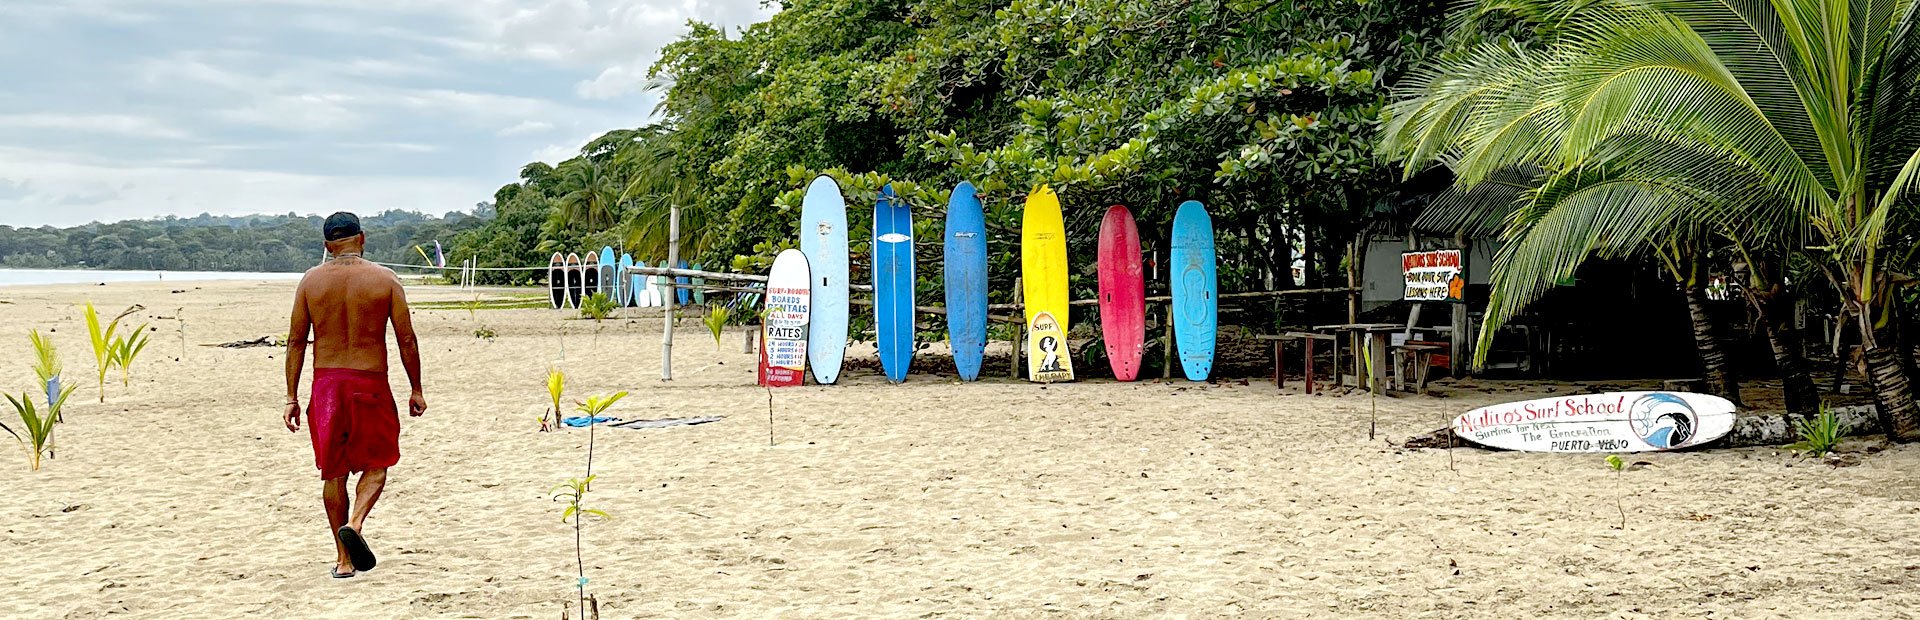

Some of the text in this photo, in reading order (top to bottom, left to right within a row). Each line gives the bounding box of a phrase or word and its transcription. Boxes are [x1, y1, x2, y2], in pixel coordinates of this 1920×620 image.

[771, 295, 801, 304] BOARDS
[1034, 323, 1053, 331] SURF
[768, 327, 801, 338] RATES
[1035, 372, 1071, 380] THERAPY
[1460, 395, 1625, 433] Nativos Surf School
[1475, 426, 1512, 440] Surfing
[1520, 432, 1542, 442] The
[1551, 439, 1590, 451] PUERTO
